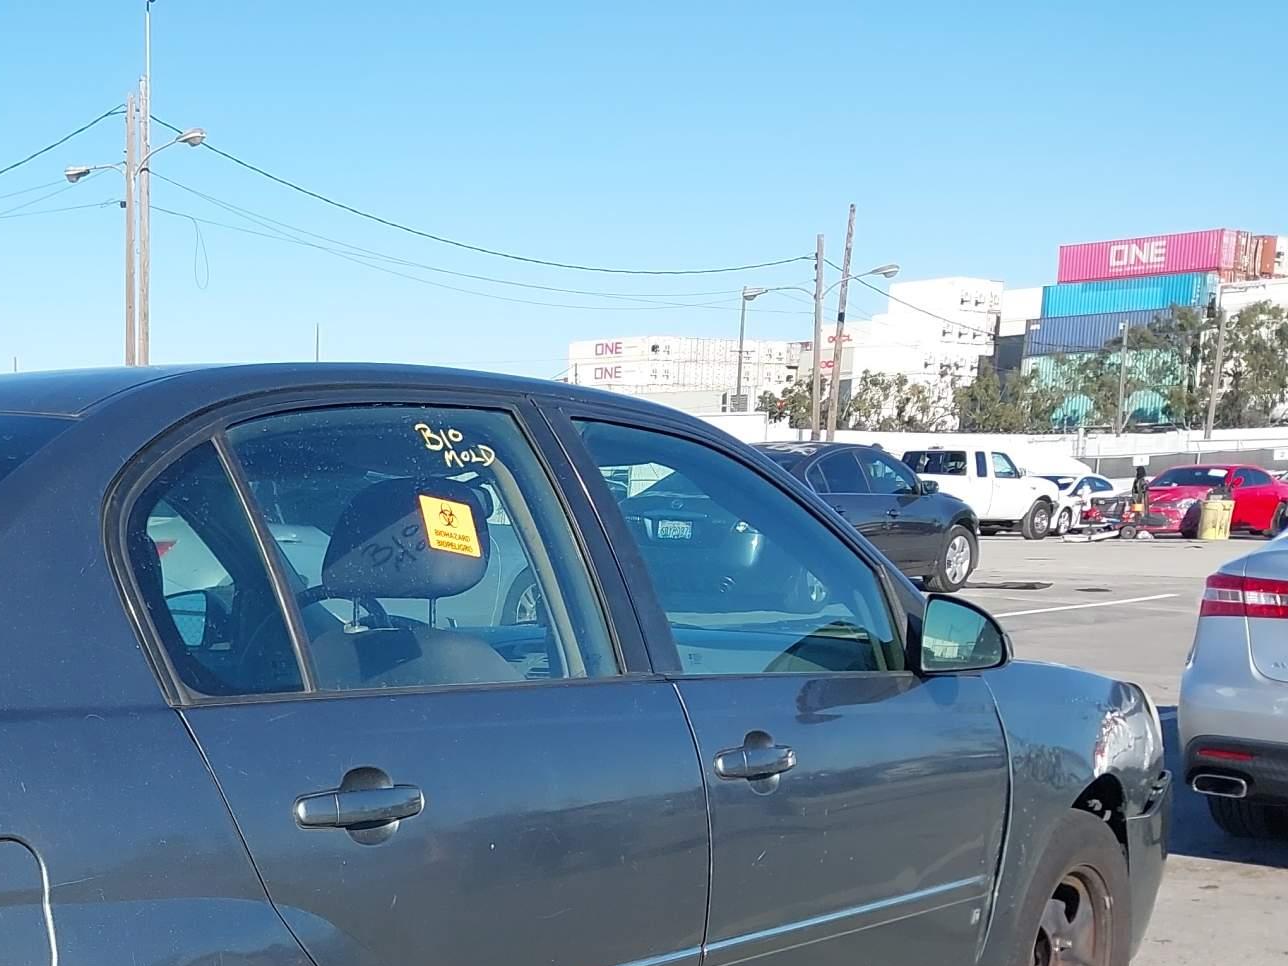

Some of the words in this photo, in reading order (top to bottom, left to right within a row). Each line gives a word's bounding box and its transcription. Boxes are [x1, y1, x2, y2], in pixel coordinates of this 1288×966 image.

[1109, 240, 1167, 267] ONE
[594, 341, 623, 356] ONE
[594, 365, 622, 380] ONE
[414, 423, 464, 451] BIO
[444, 444, 496, 468] MOLD
[434, 528, 472, 543] BIOHAZARD
